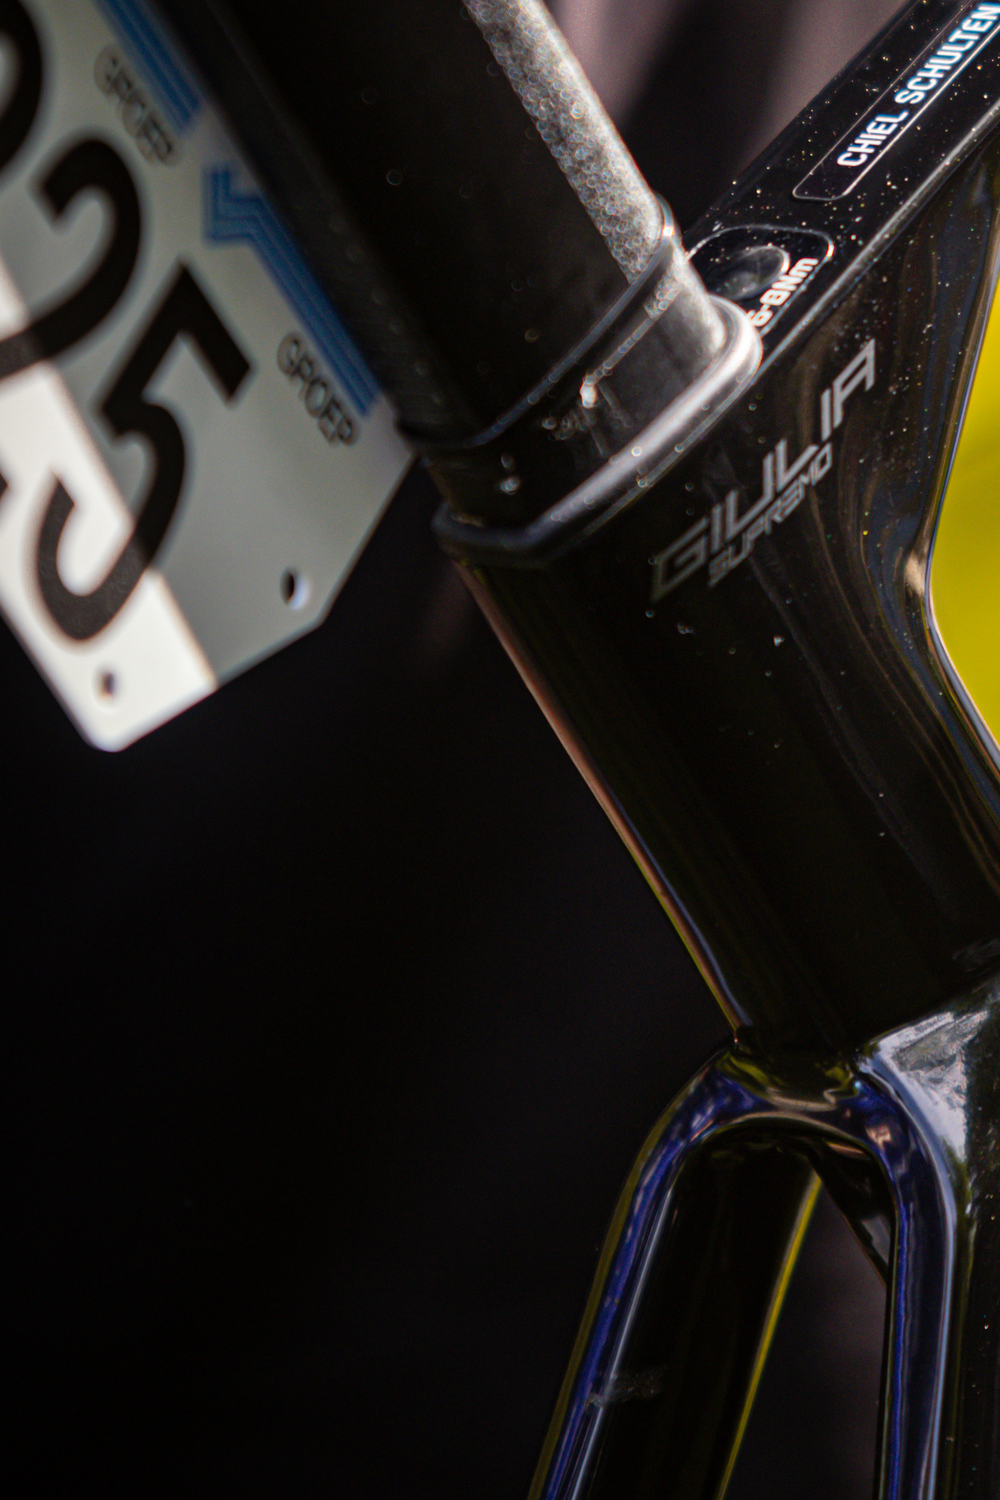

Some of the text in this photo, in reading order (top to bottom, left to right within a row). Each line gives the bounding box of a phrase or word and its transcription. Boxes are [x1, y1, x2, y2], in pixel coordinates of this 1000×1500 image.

[836, 109, 909, 168] CHIEL
[278, 333, 357, 447] GROEP
[653, 338, 876, 601] GIULIA
[708, 442, 832, 588] SUPREMO
